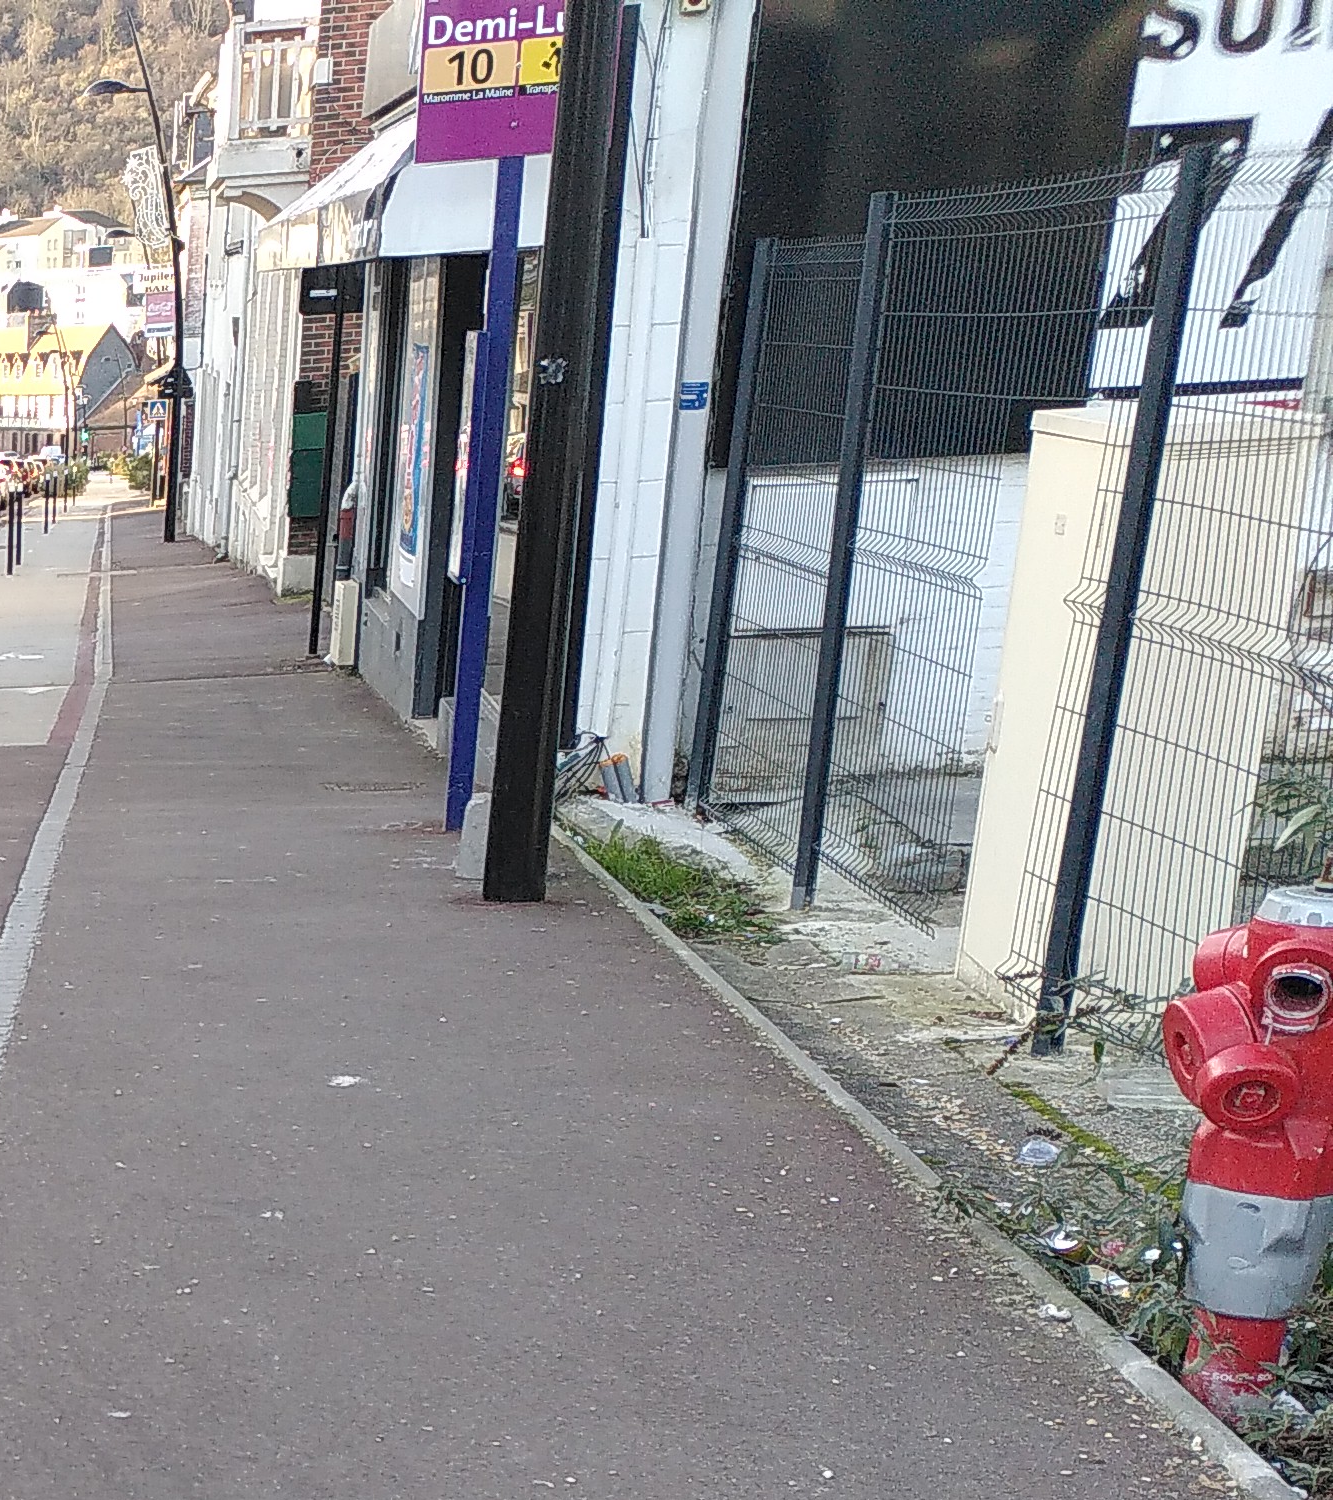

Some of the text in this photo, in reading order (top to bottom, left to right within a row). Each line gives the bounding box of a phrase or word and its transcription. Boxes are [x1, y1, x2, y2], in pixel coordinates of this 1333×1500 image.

[447, 48, 495, 86] 10
[423, 87, 514, 104] Maromme La Maine
